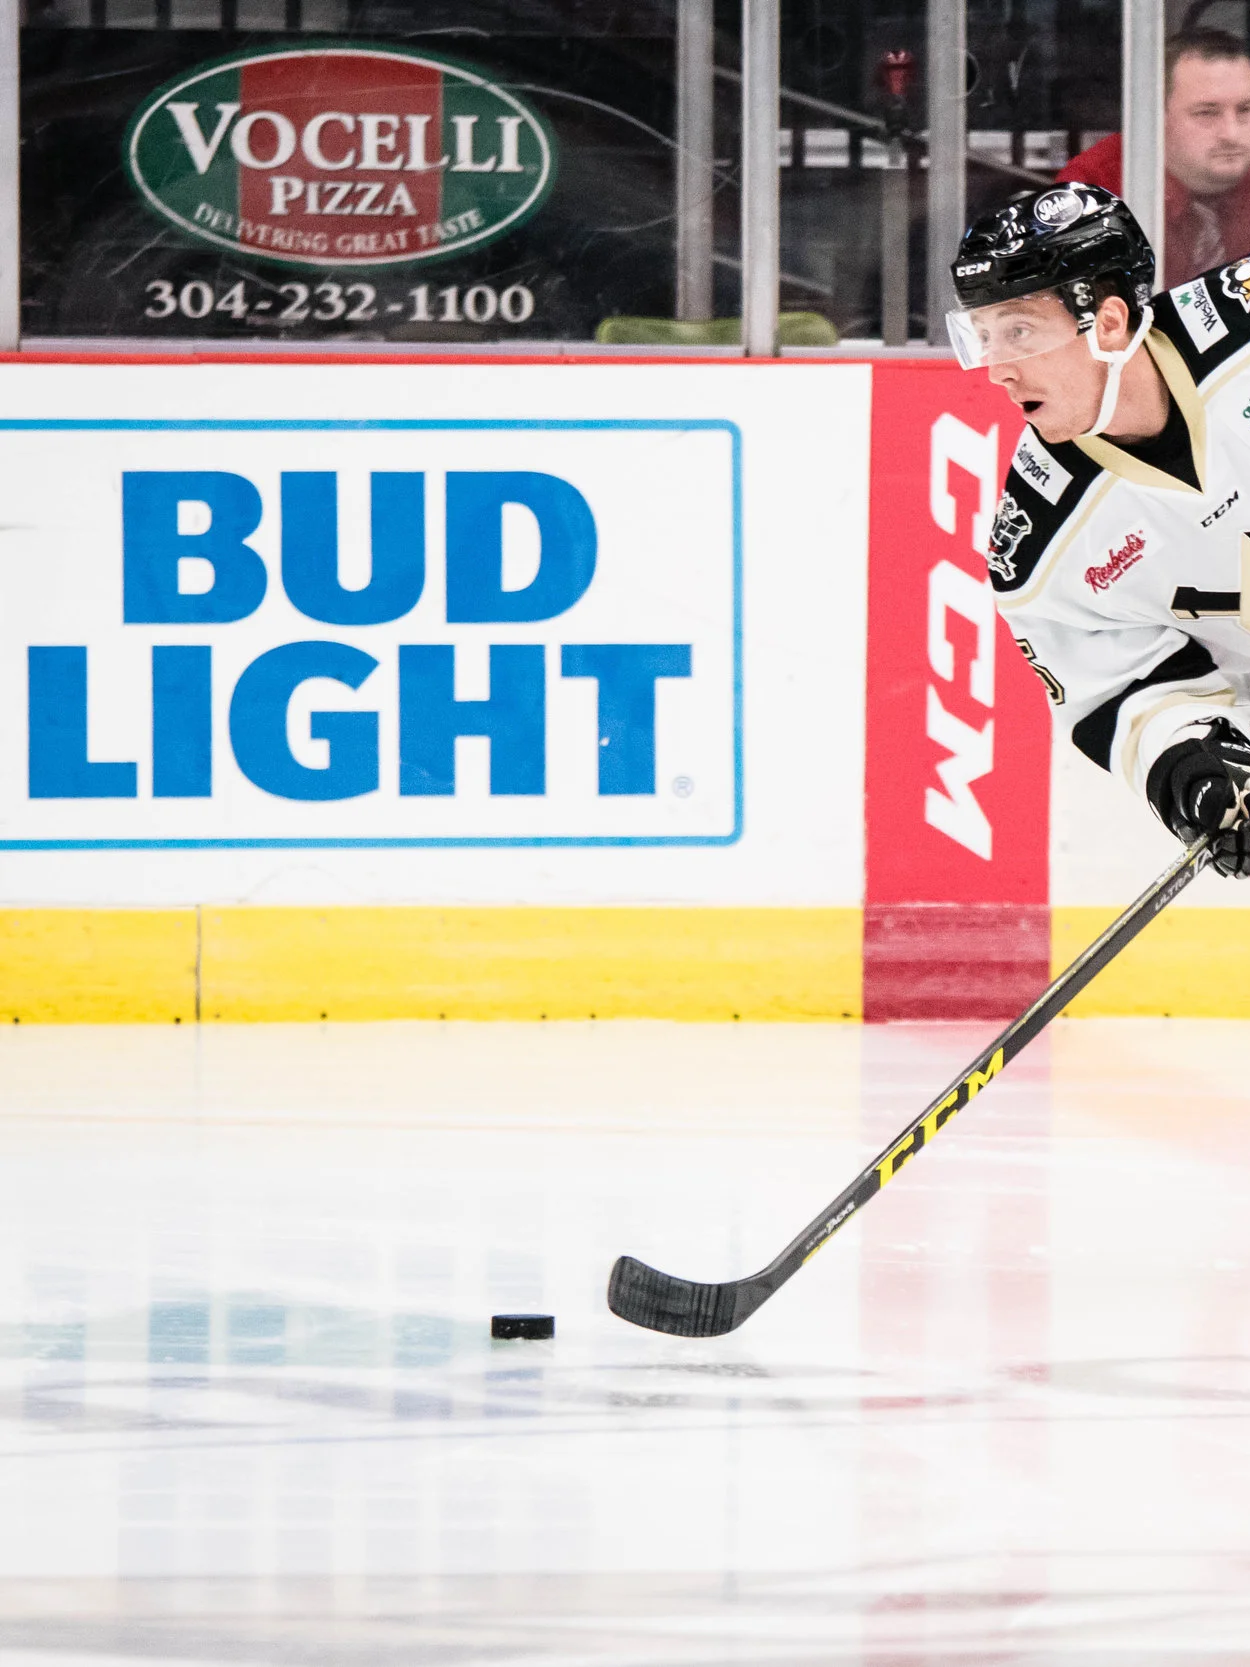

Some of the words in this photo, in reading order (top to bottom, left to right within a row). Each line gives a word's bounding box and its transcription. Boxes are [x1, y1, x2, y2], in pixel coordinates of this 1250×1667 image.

[166, 102, 526, 175] VOCELLI
[268, 175, 418, 216] PIZZA
[194, 202, 329, 252] DELIVERING
[335, 227, 410, 254] GREAT
[415, 206, 486, 245] TASTE
[956, 261, 992, 278] CCM
[143, 280, 536, 323] 304-232-1100
[1200, 490, 1239, 529] CCM
[121, 470, 599, 627] BUD
[924, 411, 1000, 861] CCM
[27, 640, 693, 802] LIGHT
[873, 1046, 1004, 1189] CCM
